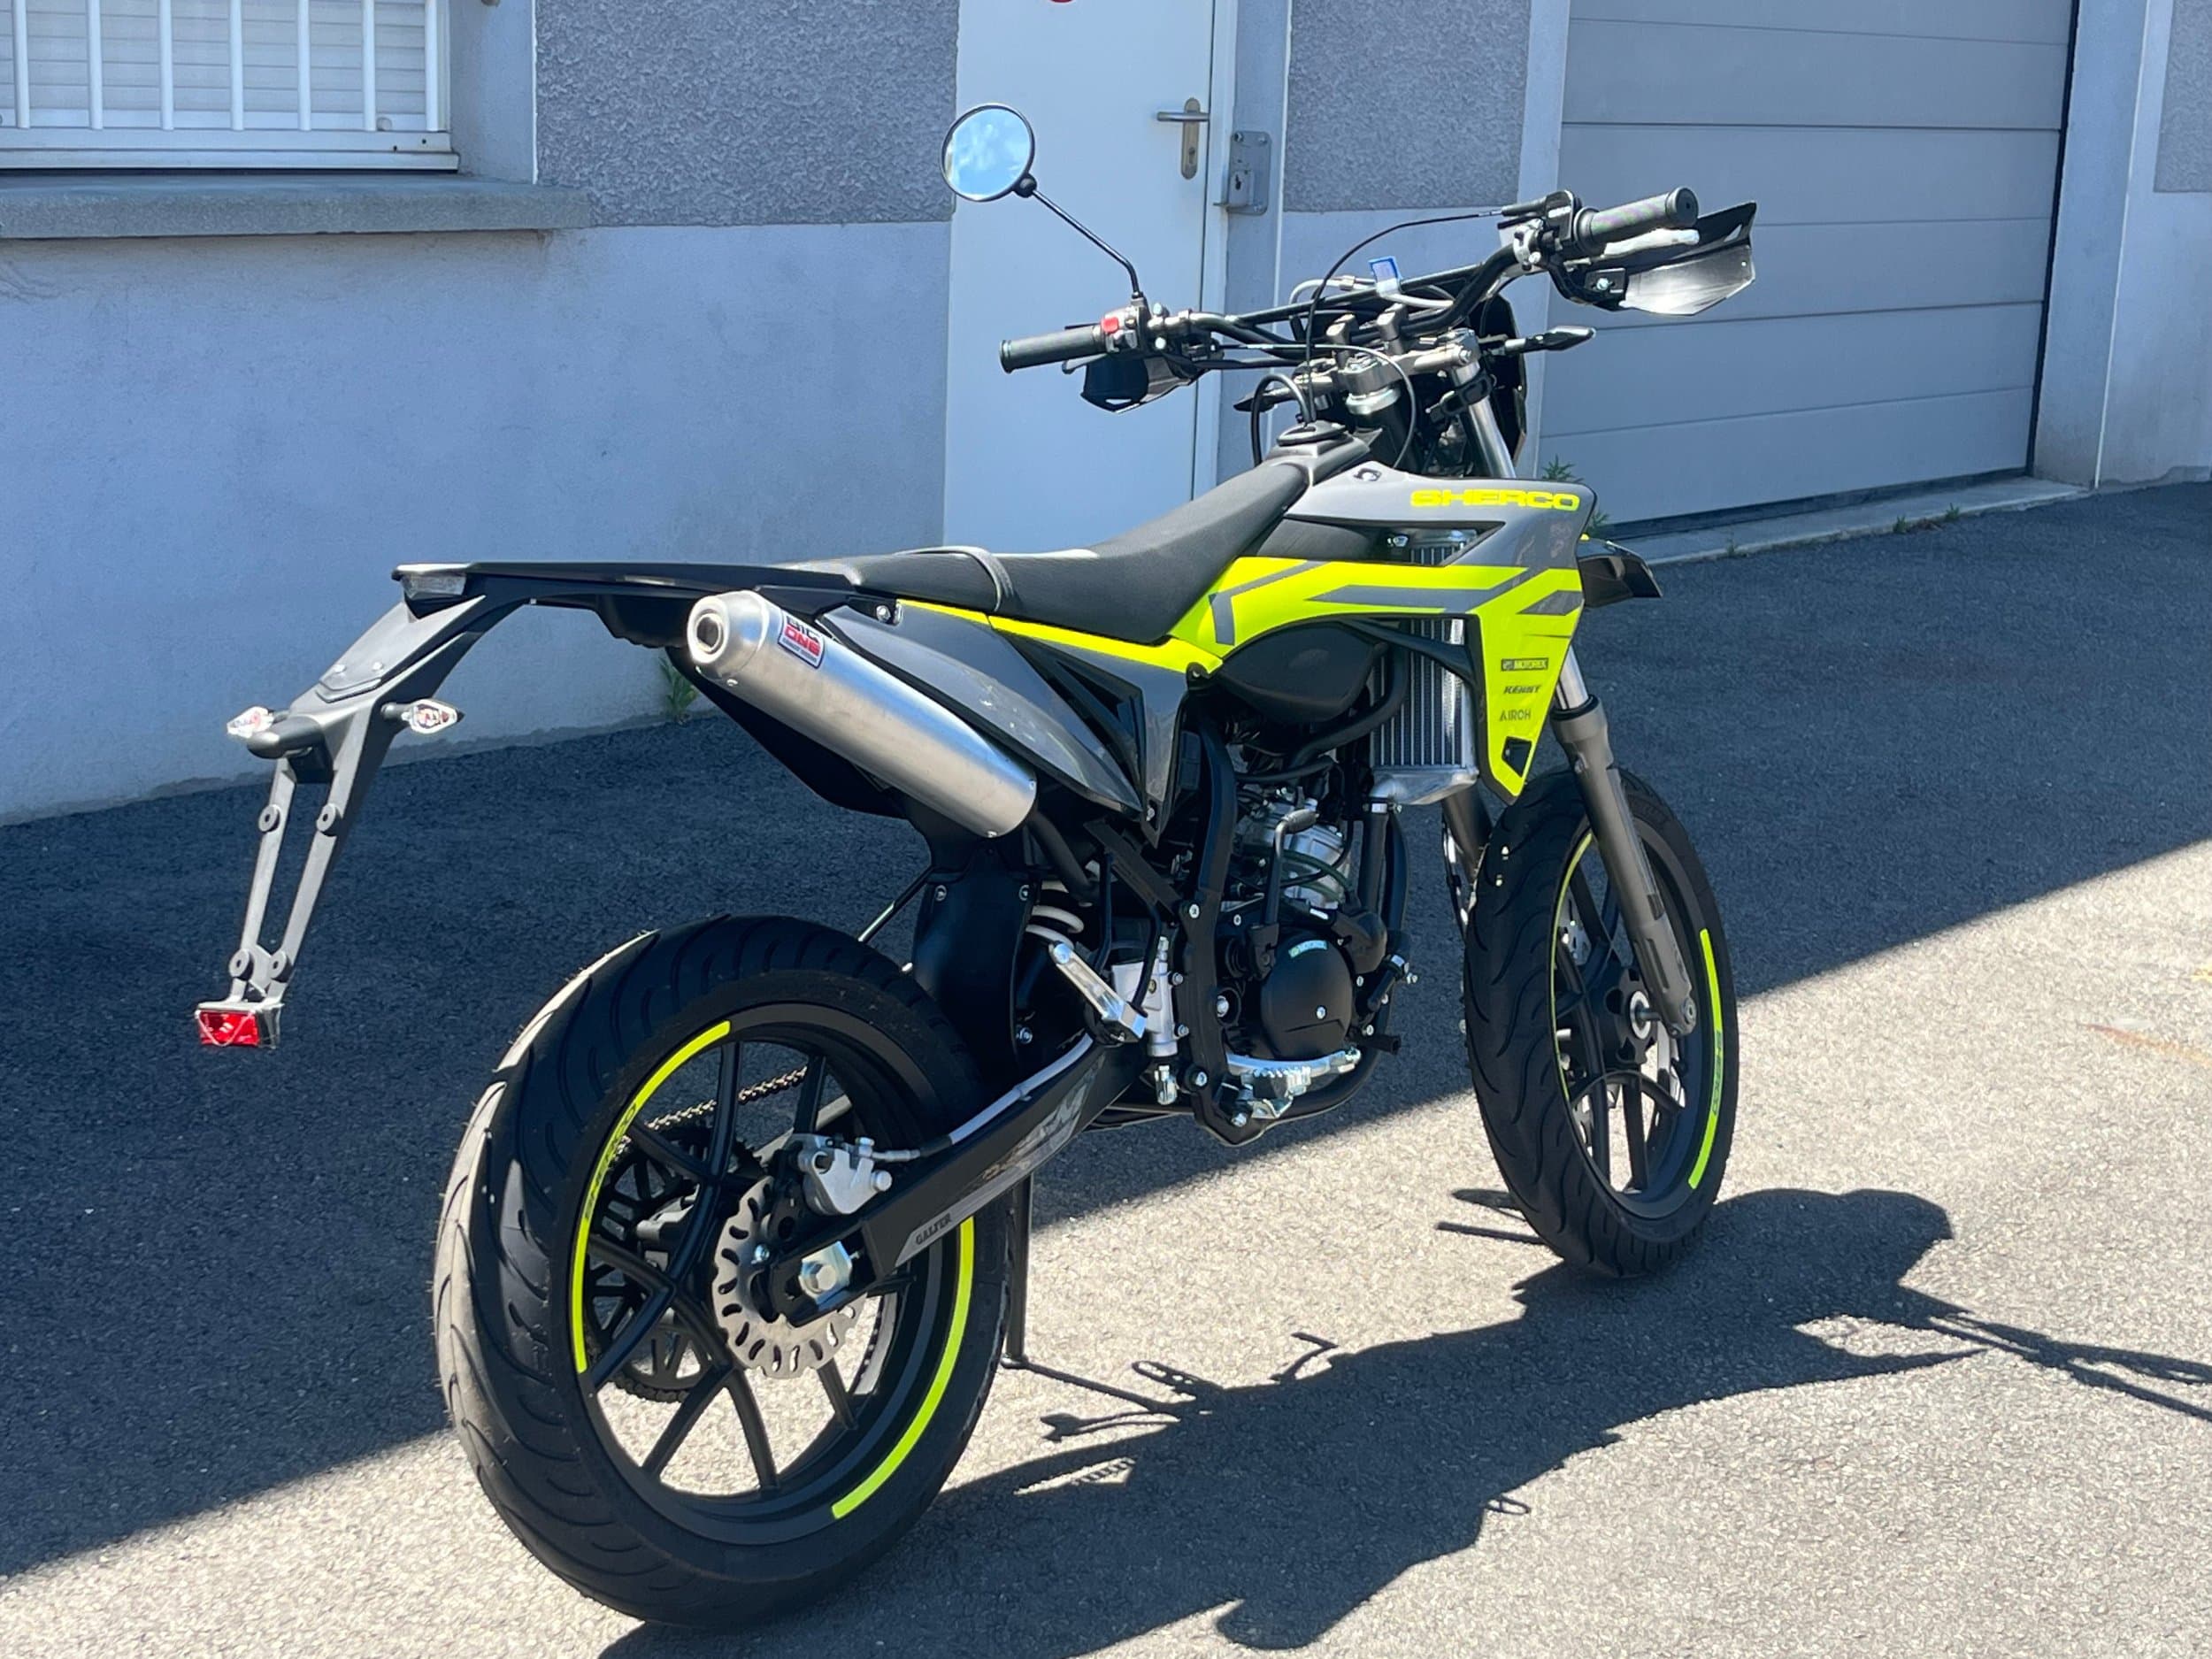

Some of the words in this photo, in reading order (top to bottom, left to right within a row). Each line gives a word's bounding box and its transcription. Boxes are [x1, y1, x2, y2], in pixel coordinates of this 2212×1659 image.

[1410, 489, 1580, 511] SHERCO
[784, 625, 821, 657] ONE
[1500, 709, 1531, 721] AIROH
[916, 1212, 951, 1245] GALFER
